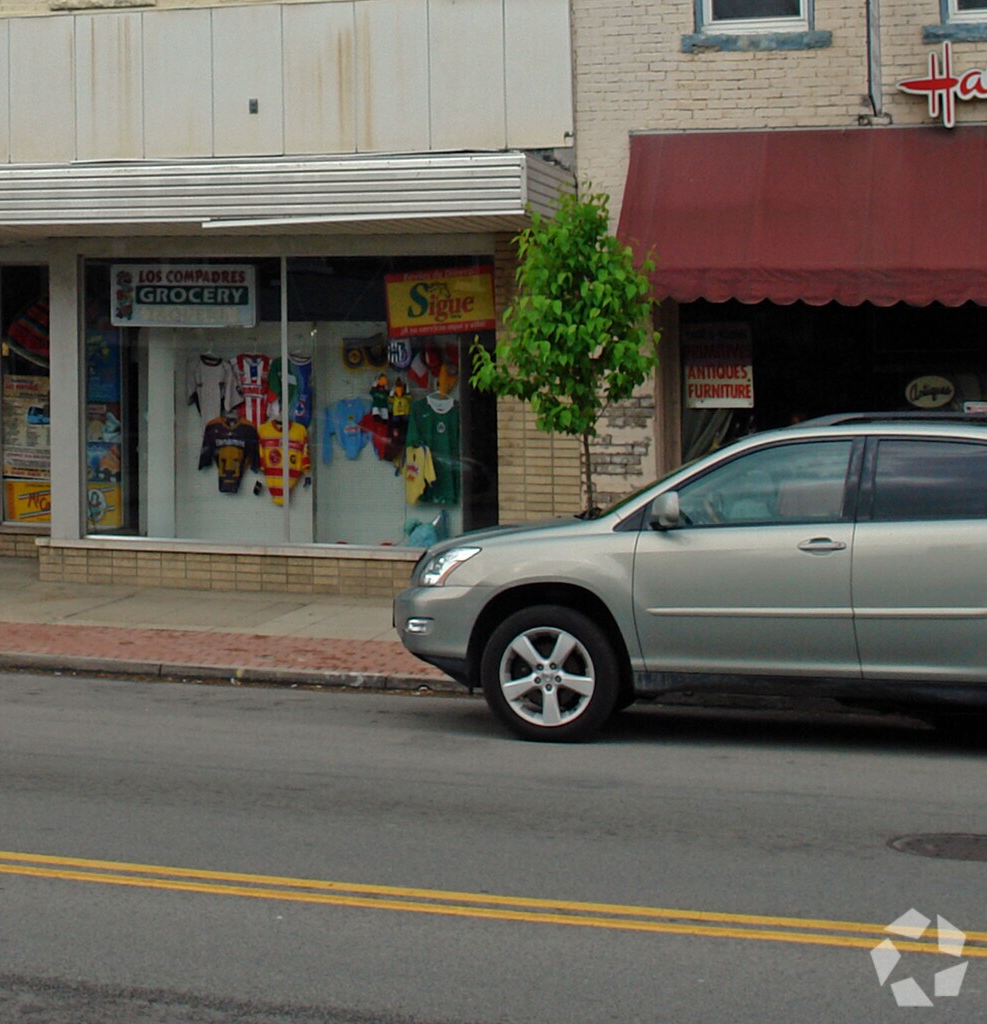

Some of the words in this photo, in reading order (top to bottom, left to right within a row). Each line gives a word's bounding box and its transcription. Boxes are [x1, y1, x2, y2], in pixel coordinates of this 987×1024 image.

[139, 270, 162, 284] LOS
[165, 270, 246, 284] COMPADRES
[139, 287, 245, 304] GROCERY
[407, 282, 474, 322] Sigue
[687, 365, 748, 380] ANTIQUES
[687, 383, 752, 399] FURNITURE
